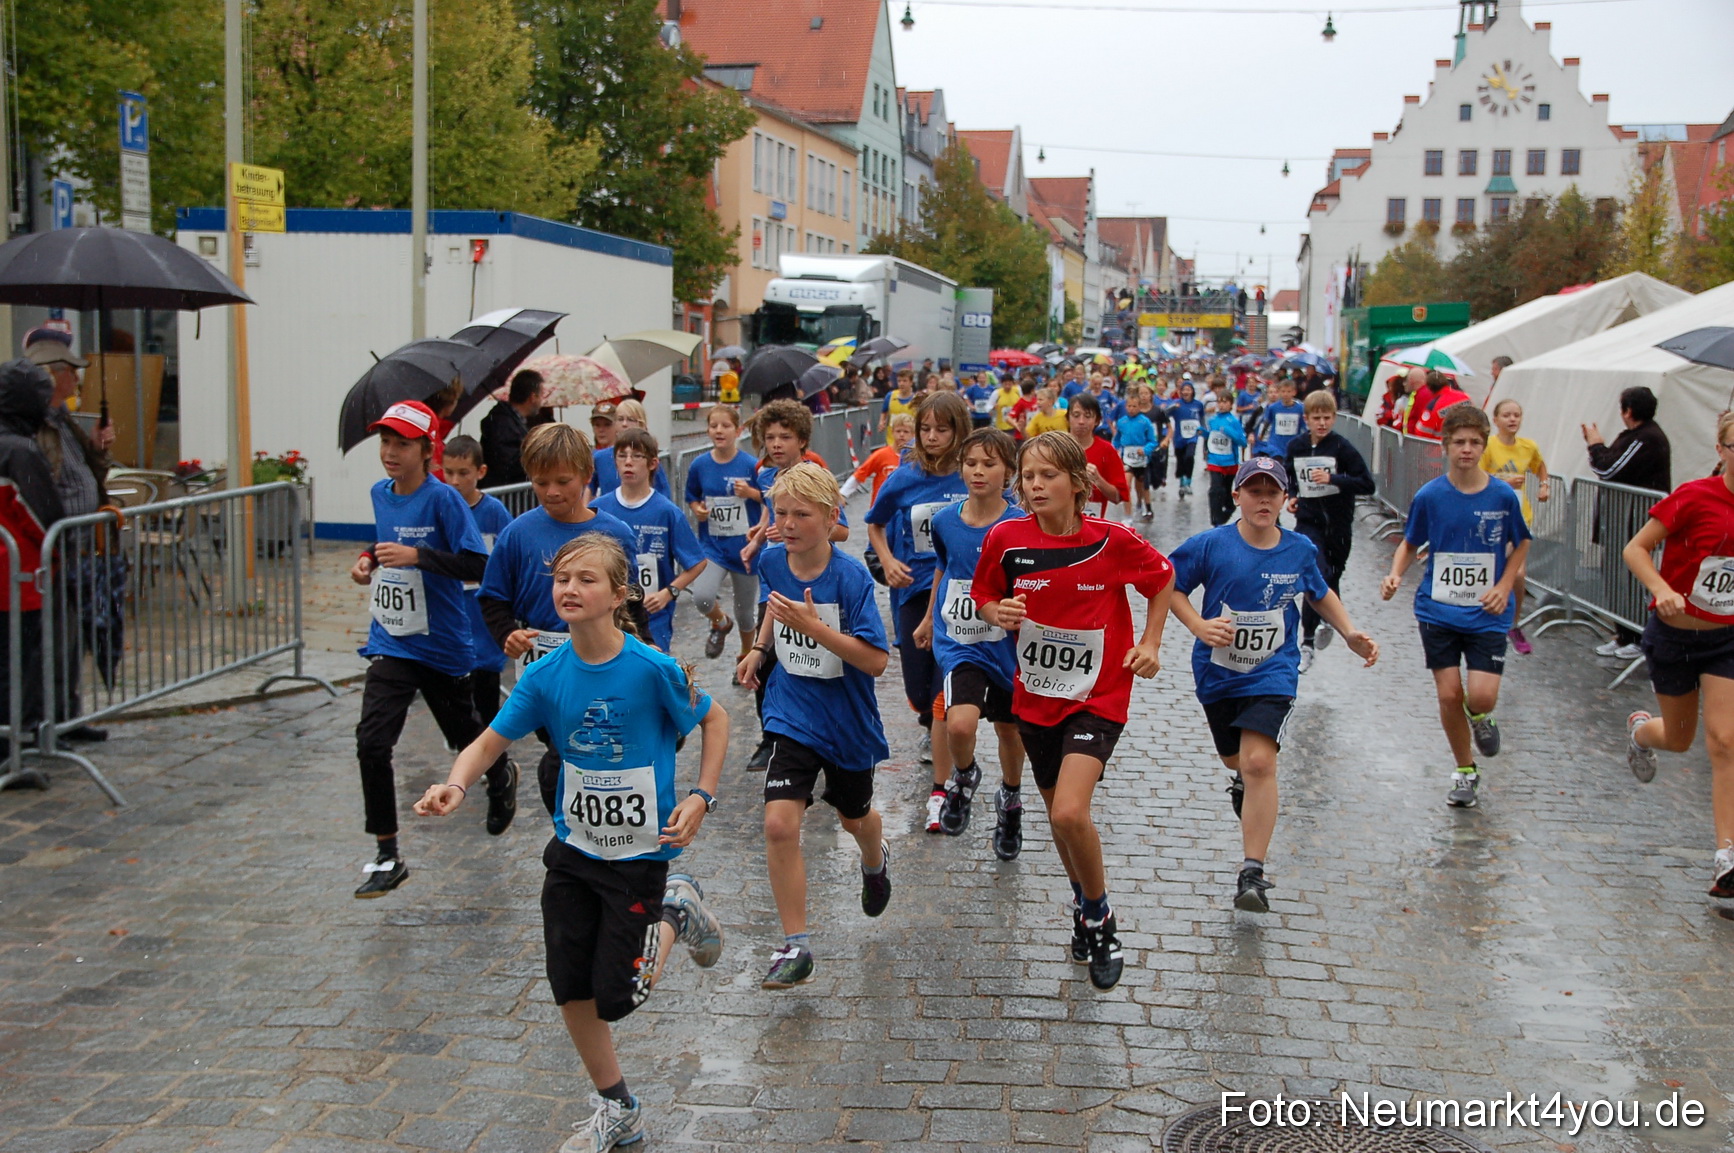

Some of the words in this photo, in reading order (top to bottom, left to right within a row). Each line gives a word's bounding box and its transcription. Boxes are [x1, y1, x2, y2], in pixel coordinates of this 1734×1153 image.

[57, 188, 70, 230] P
[789, 288, 840, 300] BOCK
[1168, 316, 1200, 324] START
[710, 506, 741, 522] 4077
[1440, 567, 1488, 587] 4054
[374, 584, 415, 612] 4061
[382, 615, 404, 626] David
[955, 624, 993, 635] Dominik
[1042, 630, 1078, 641] BOCK
[789, 651, 821, 669] Philipp
[1022, 641, 1093, 675] 4094
[1228, 652, 1264, 665] Manuel
[1025, 670, 1075, 693] Tobias
[582, 775, 622, 787] BOCK
[569, 790, 646, 828] 4083
[585, 829, 634, 848] Marlene
